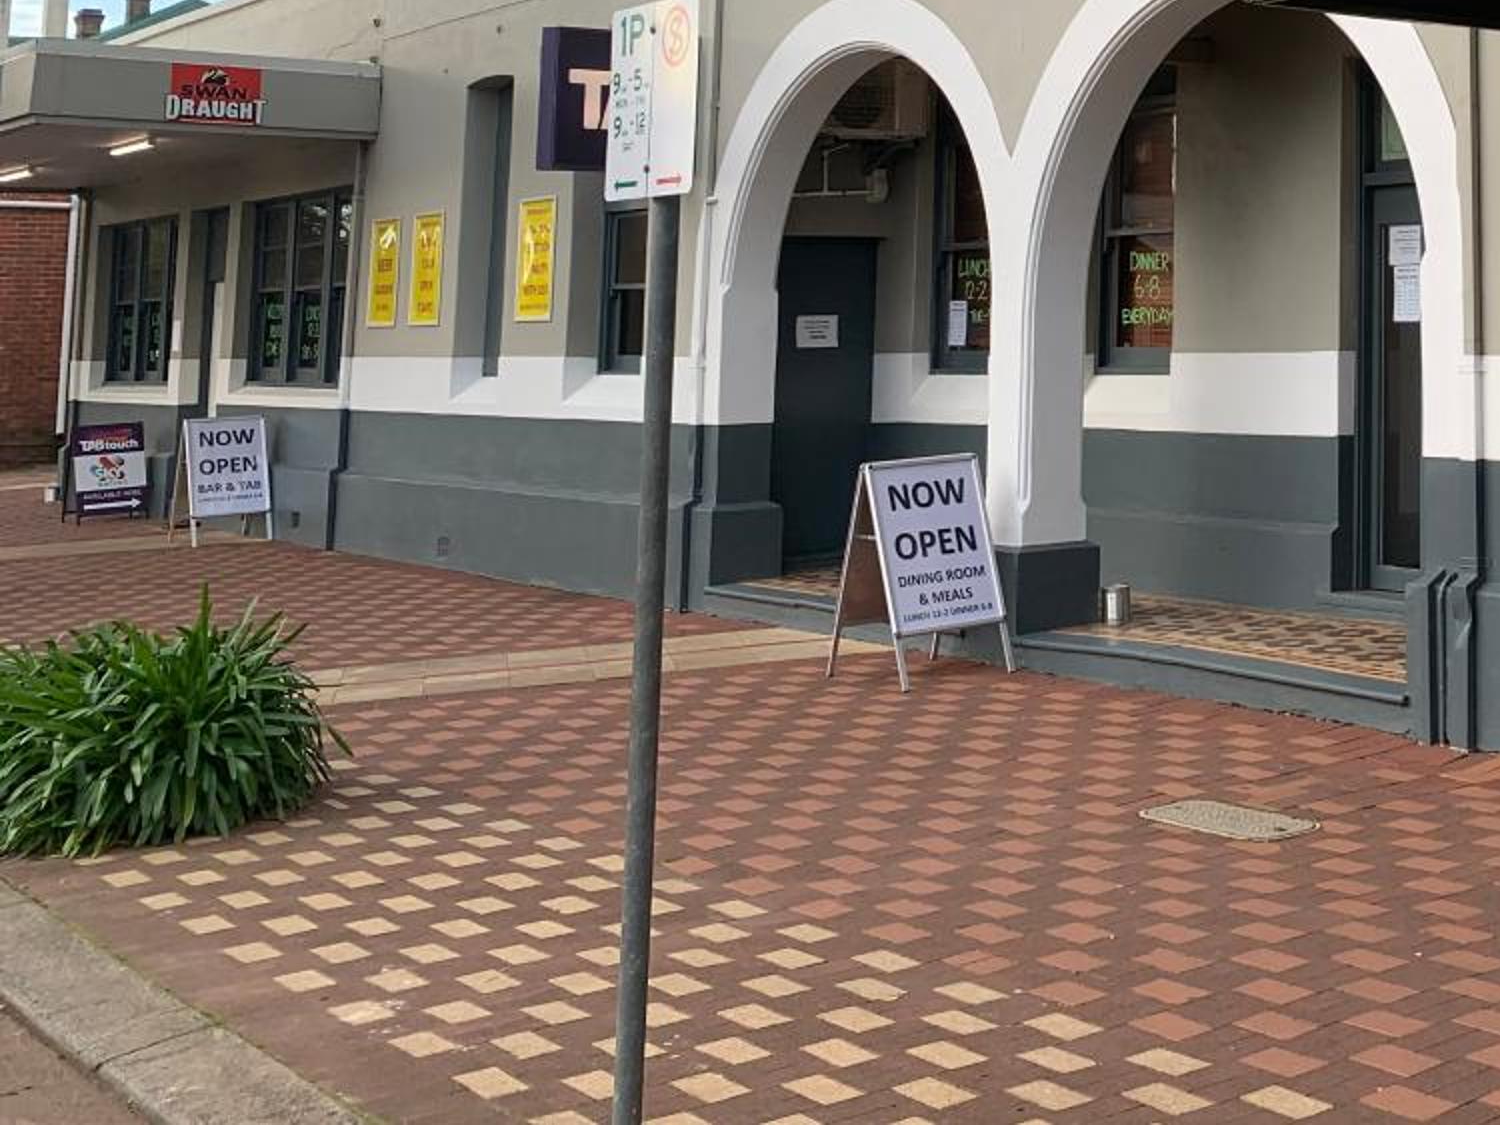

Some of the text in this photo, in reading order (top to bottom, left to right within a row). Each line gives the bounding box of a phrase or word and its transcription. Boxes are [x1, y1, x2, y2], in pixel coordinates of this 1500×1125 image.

[620, 14, 646, 57] 1P
[181, 84, 248, 100] SWAN
[164, 94, 268, 124] DRAUGHT
[1129, 251, 1169, 272] DINNER
[199, 428, 255, 447] NOW
[199, 456, 258, 476] OPEN
[197, 482, 223, 493] BAR
[887, 477, 965, 512] NOW
[894, 525, 978, 560] OPEN
[897, 565, 986, 588] DINING ROOM
[919, 586, 974, 605] & MEALS
[903, 611, 931, 623] LUNCH
